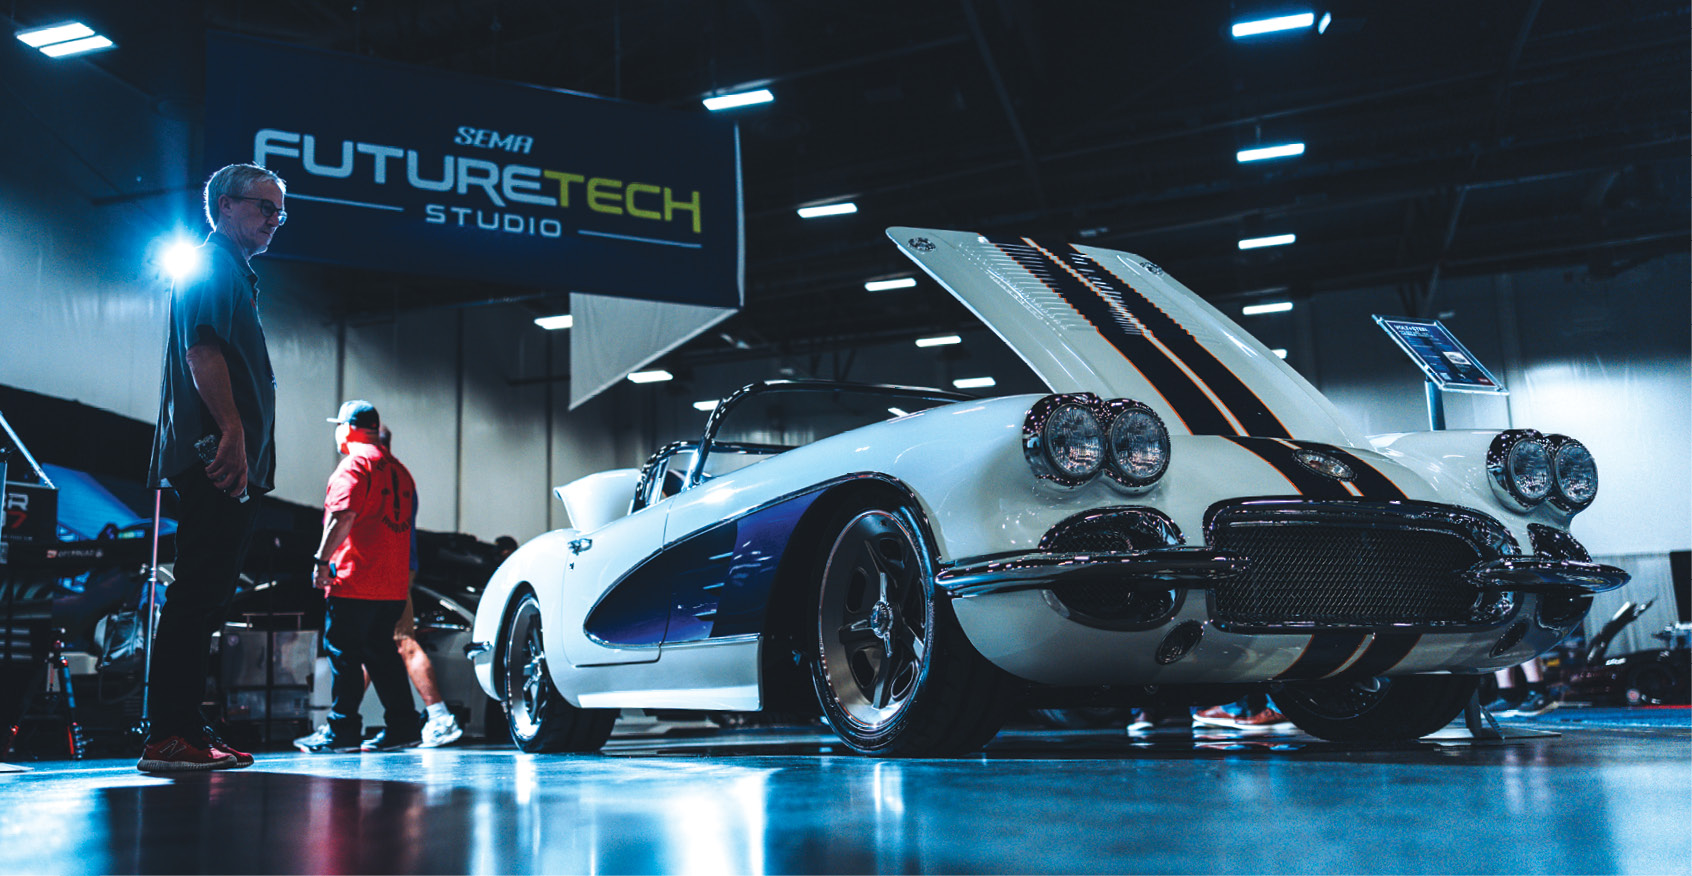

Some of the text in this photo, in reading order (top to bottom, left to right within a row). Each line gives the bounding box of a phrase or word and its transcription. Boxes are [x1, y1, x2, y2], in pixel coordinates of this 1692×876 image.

[454, 126, 534, 154] SEMA
[254, 128, 701, 233] FUTURETECH
[425, 204, 562, 237] STUDIO
